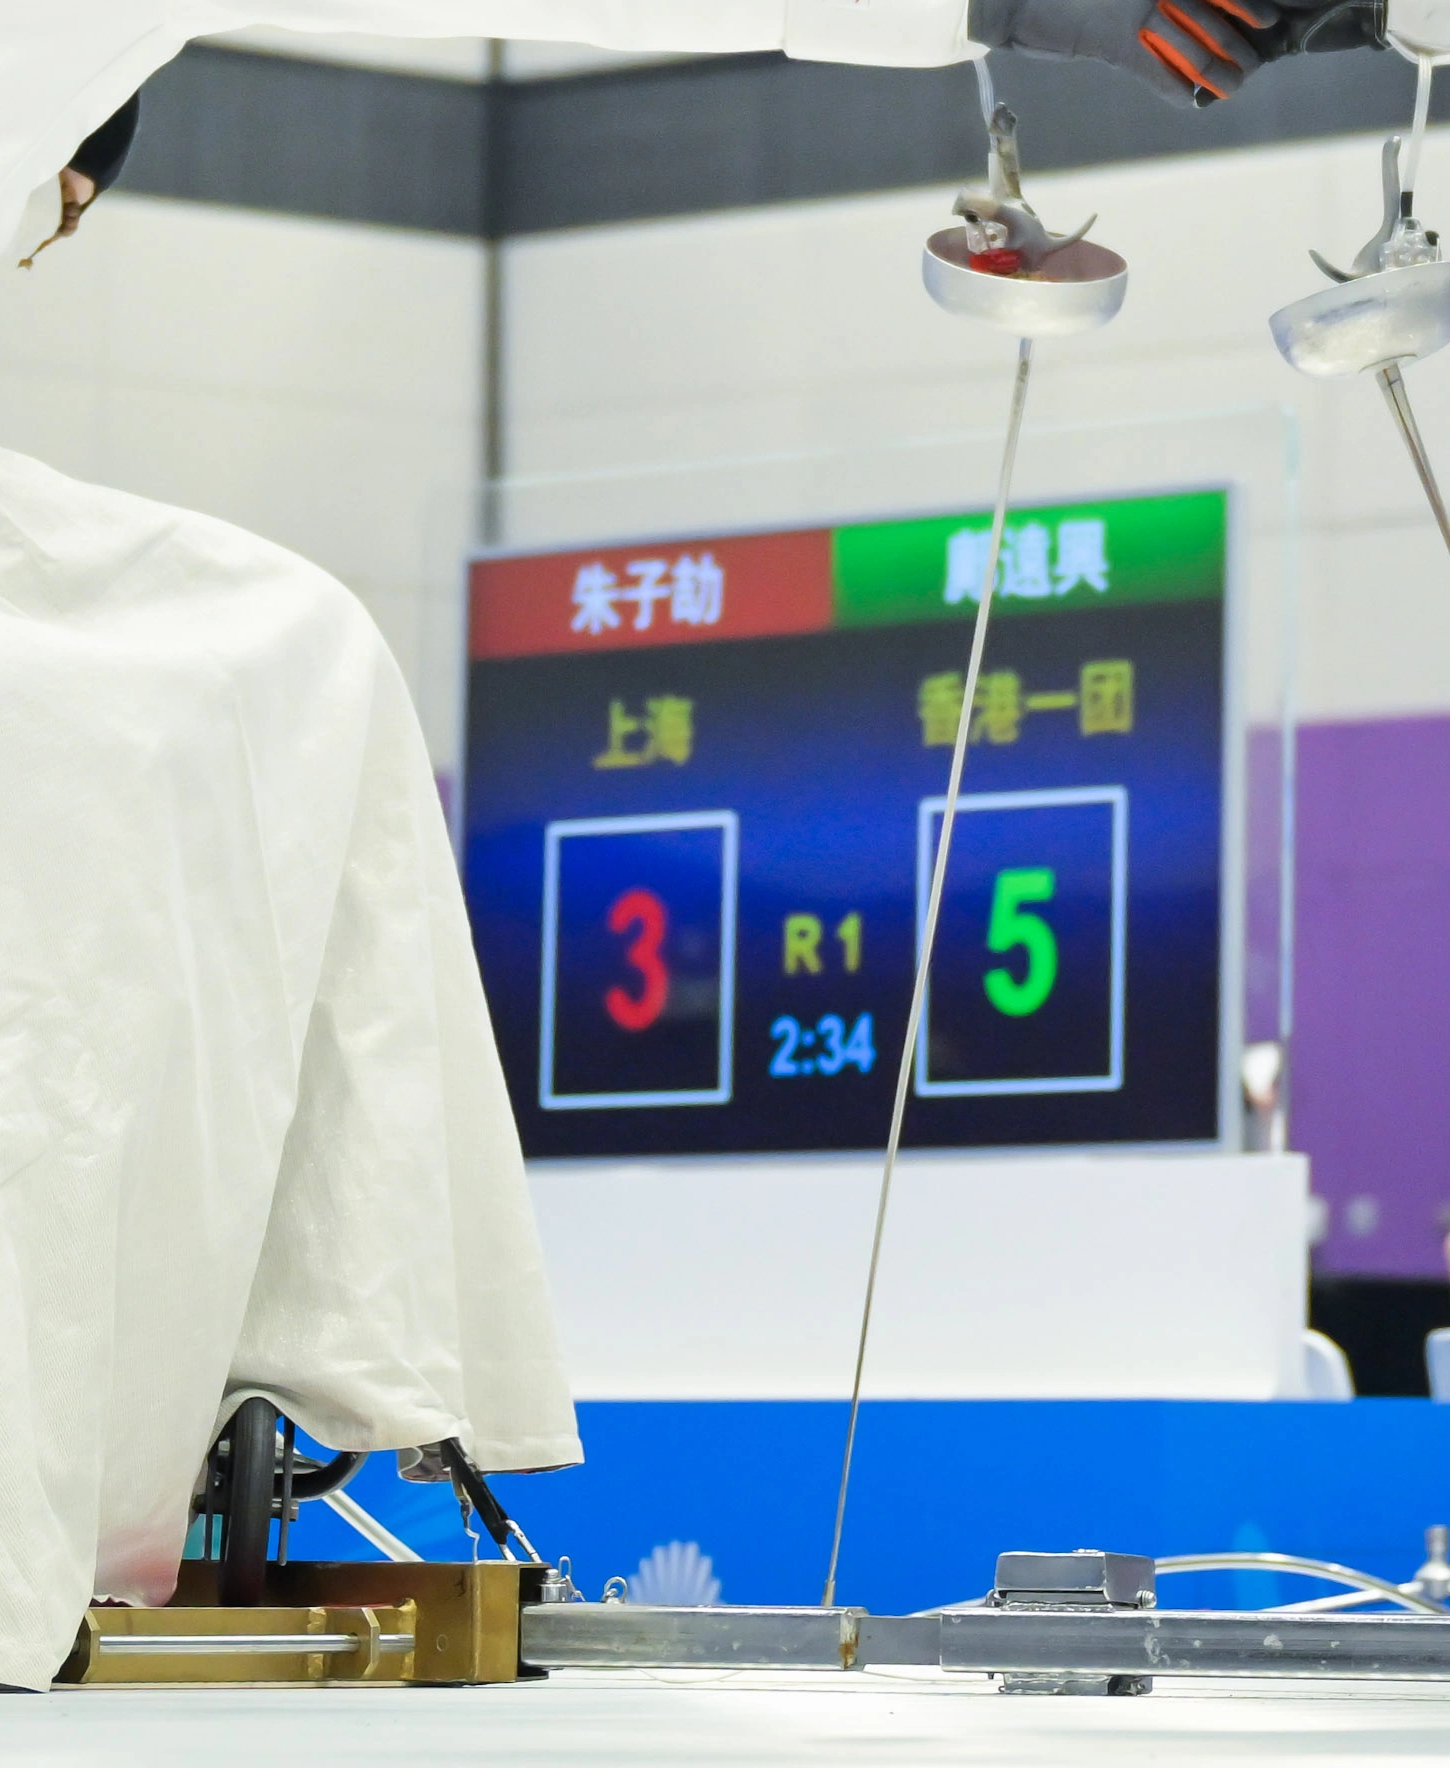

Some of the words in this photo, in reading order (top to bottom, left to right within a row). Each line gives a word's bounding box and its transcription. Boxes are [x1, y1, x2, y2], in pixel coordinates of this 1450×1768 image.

[591, 694, 694, 770] 上海
[604, 887, 670, 1032] 3
[782, 915, 823, 975] R
[837, 912, 862, 973] 1
[980, 866, 1060, 1018] 5
[767, 1012, 877, 1079] 2:34
